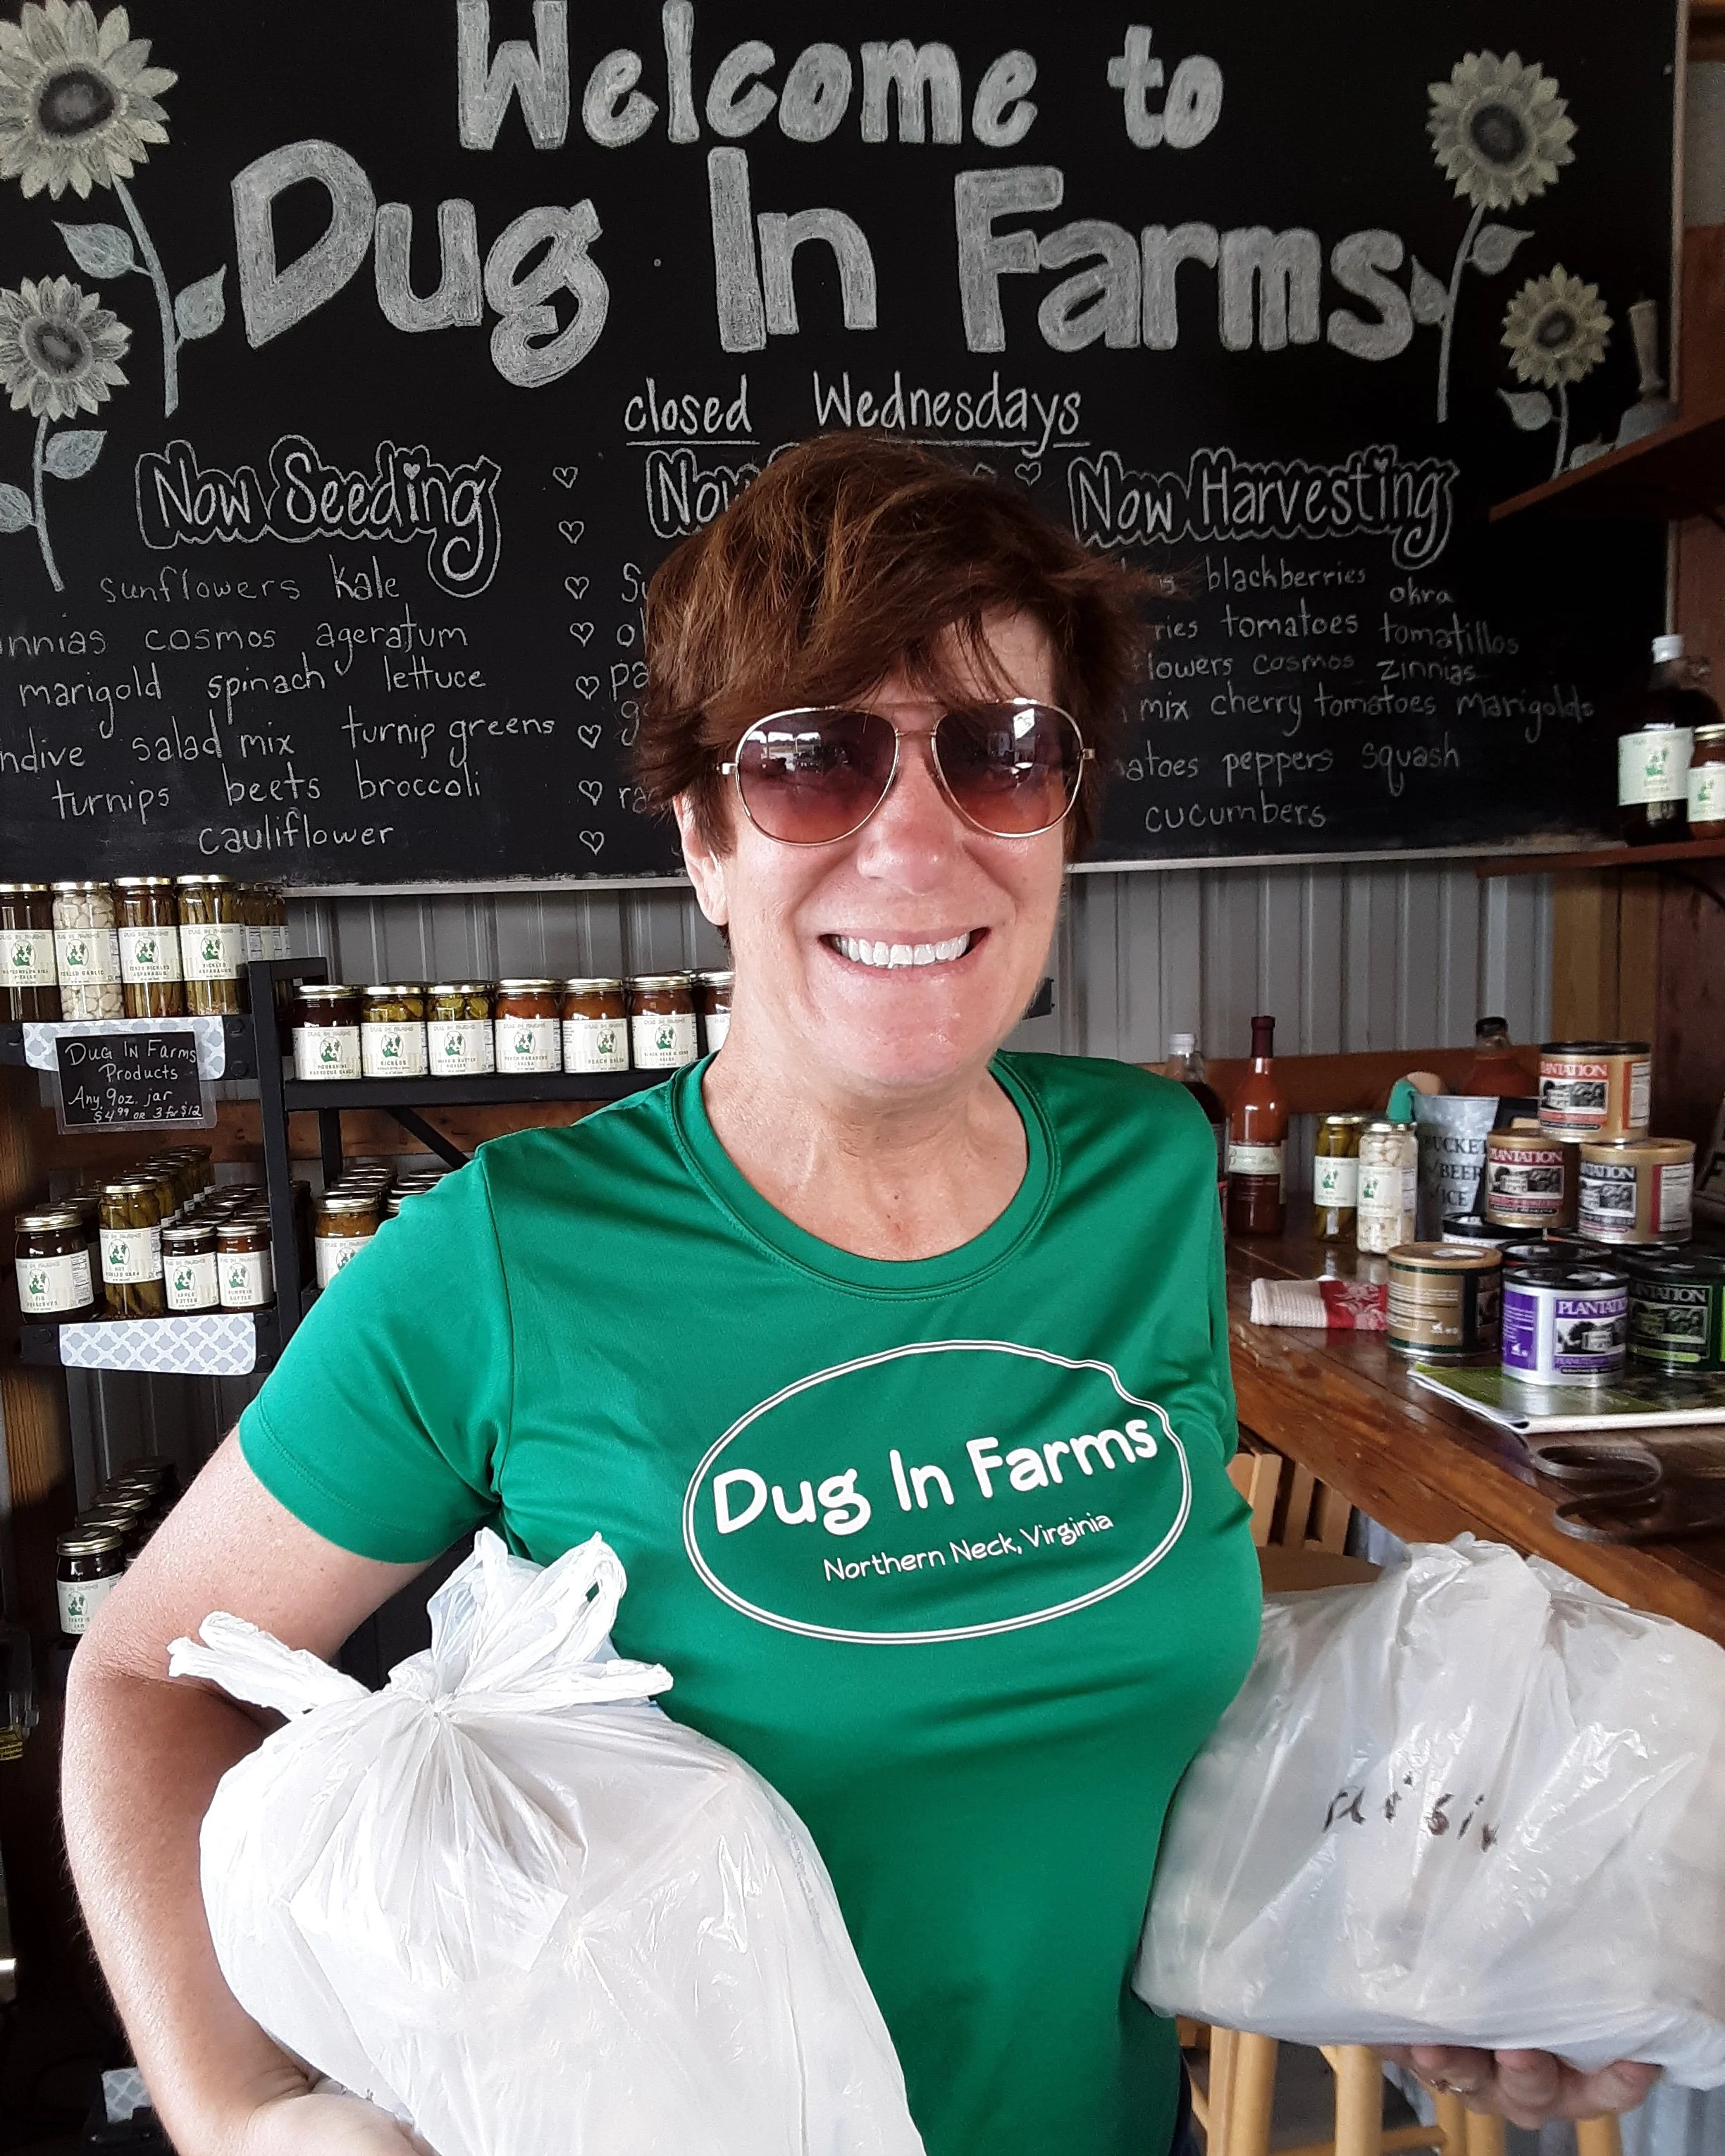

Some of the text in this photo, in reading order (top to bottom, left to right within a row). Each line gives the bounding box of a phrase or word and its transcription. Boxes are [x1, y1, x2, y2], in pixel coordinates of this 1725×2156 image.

[457, 0, 1225, 149] Welcome to
[230, 140, 1414, 388] Dug In Farms
[624, 371, 1082, 459] closed Wednesdays
[149, 447, 490, 585] Now Seeding
[1075, 454, 1447, 562] Now Harvesting
[100, 555, 400, 603] sunflowers kale
[1206, 554, 1367, 593] blackberries
[1390, 577, 1454, 605] okra
[0, 602, 468, 676] nnias cosmos ageratum
[1220, 597, 1359, 637] tomatoes
[1379, 612, 1519, 655] tomatillos
[19, 651, 487, 739] marigold spinach lettuce
[1253, 654, 1355, 676] cosmos
[1376, 655, 1477, 686] zinnias
[0, 705, 555, 774] ndive salad mix turnip greens
[1139, 681, 1595, 743] mix cherry tomatoes marigolds
[51, 759, 481, 825] turnips beets broccoli
[1221, 748, 1334, 788] peppers
[1361, 731, 1460, 797] squash
[199, 807, 395, 855] cauliflower
[1145, 790, 1326, 833] cucumbers
[98, 1062, 178, 1083] Products
[147, 1039, 197, 1063] Farms
[143, 1088, 173, 1107] jar
[152, 1106, 163, 1119] 3
[712, 1418, 1159, 1536] Dug In Farms
[822, 1511, 1114, 1582] Northern Neck, Virginia
